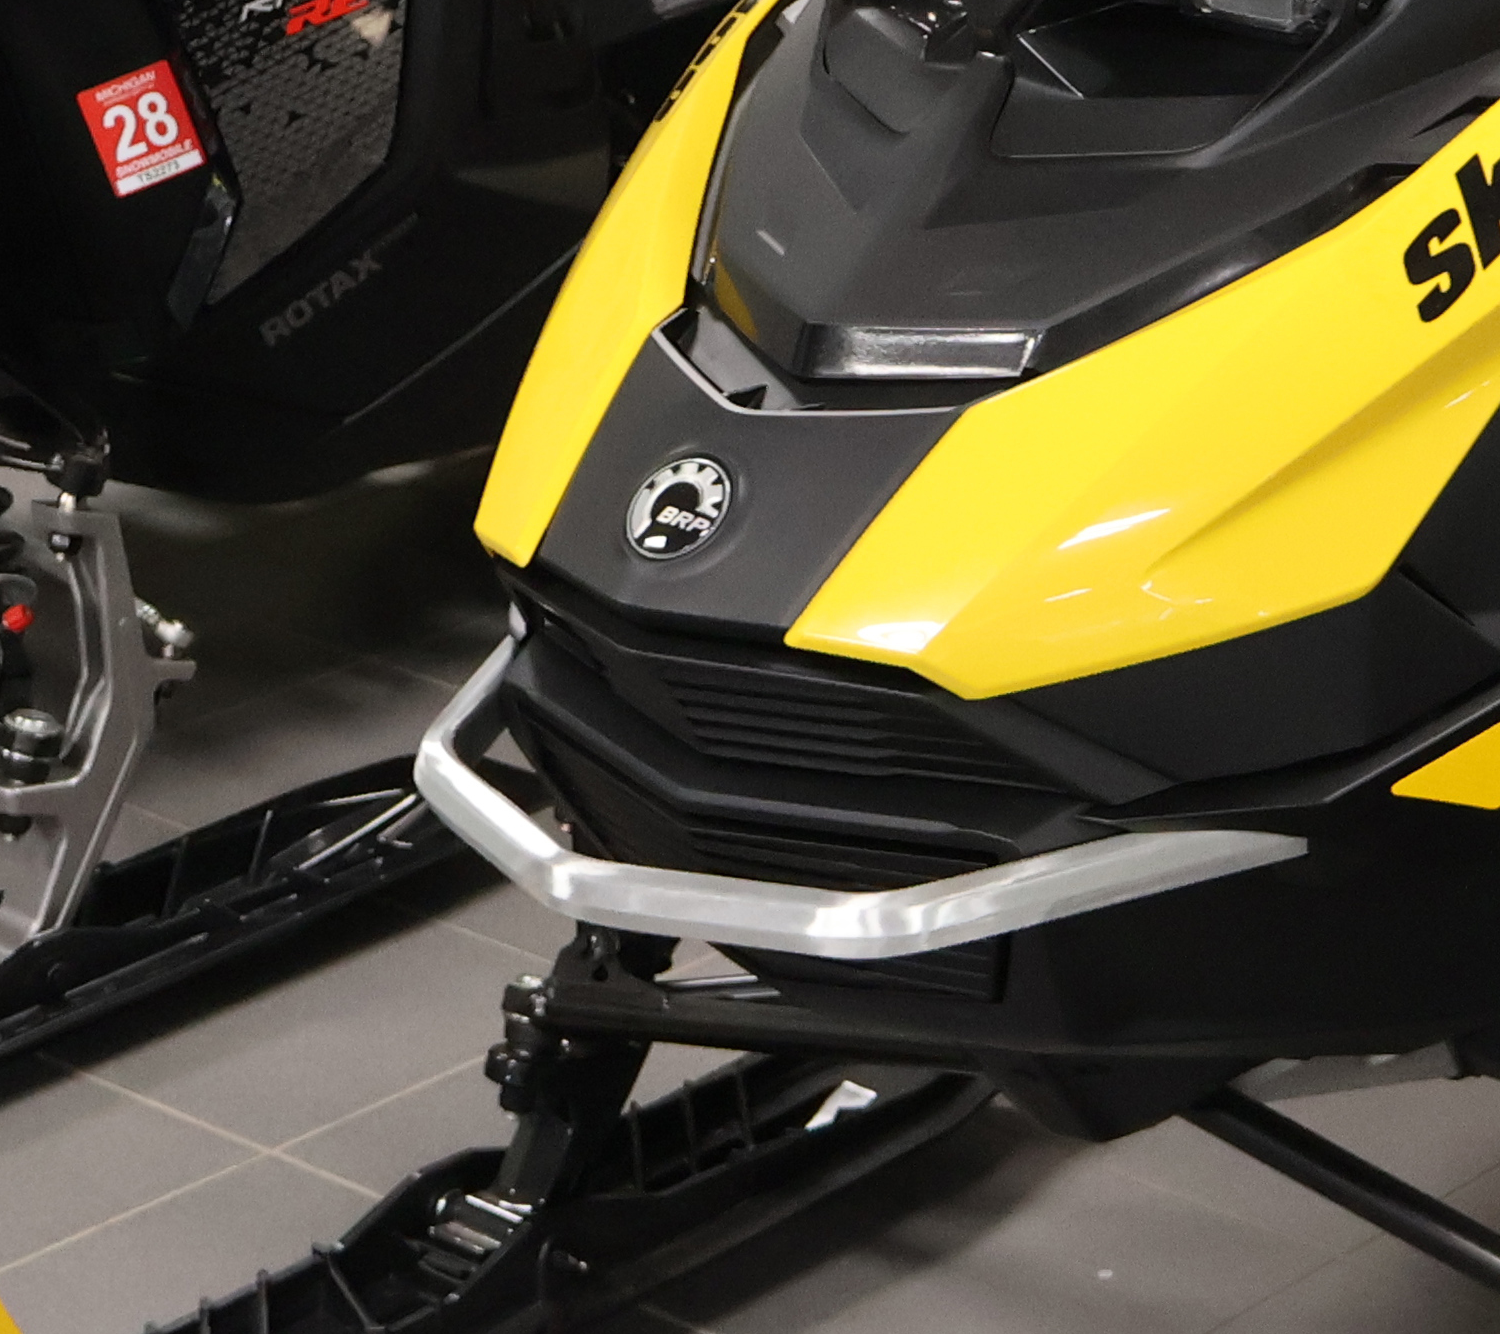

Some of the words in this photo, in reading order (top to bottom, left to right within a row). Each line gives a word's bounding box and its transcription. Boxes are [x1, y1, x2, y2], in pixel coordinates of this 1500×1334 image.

[95, 71, 156, 102] MICHIGAN
[102, 91, 179, 163] 28
[114, 139, 193, 179] SNOWMOBILE
[258, 248, 383, 348] ROTAX
[655, 505, 712, 532] BRP
